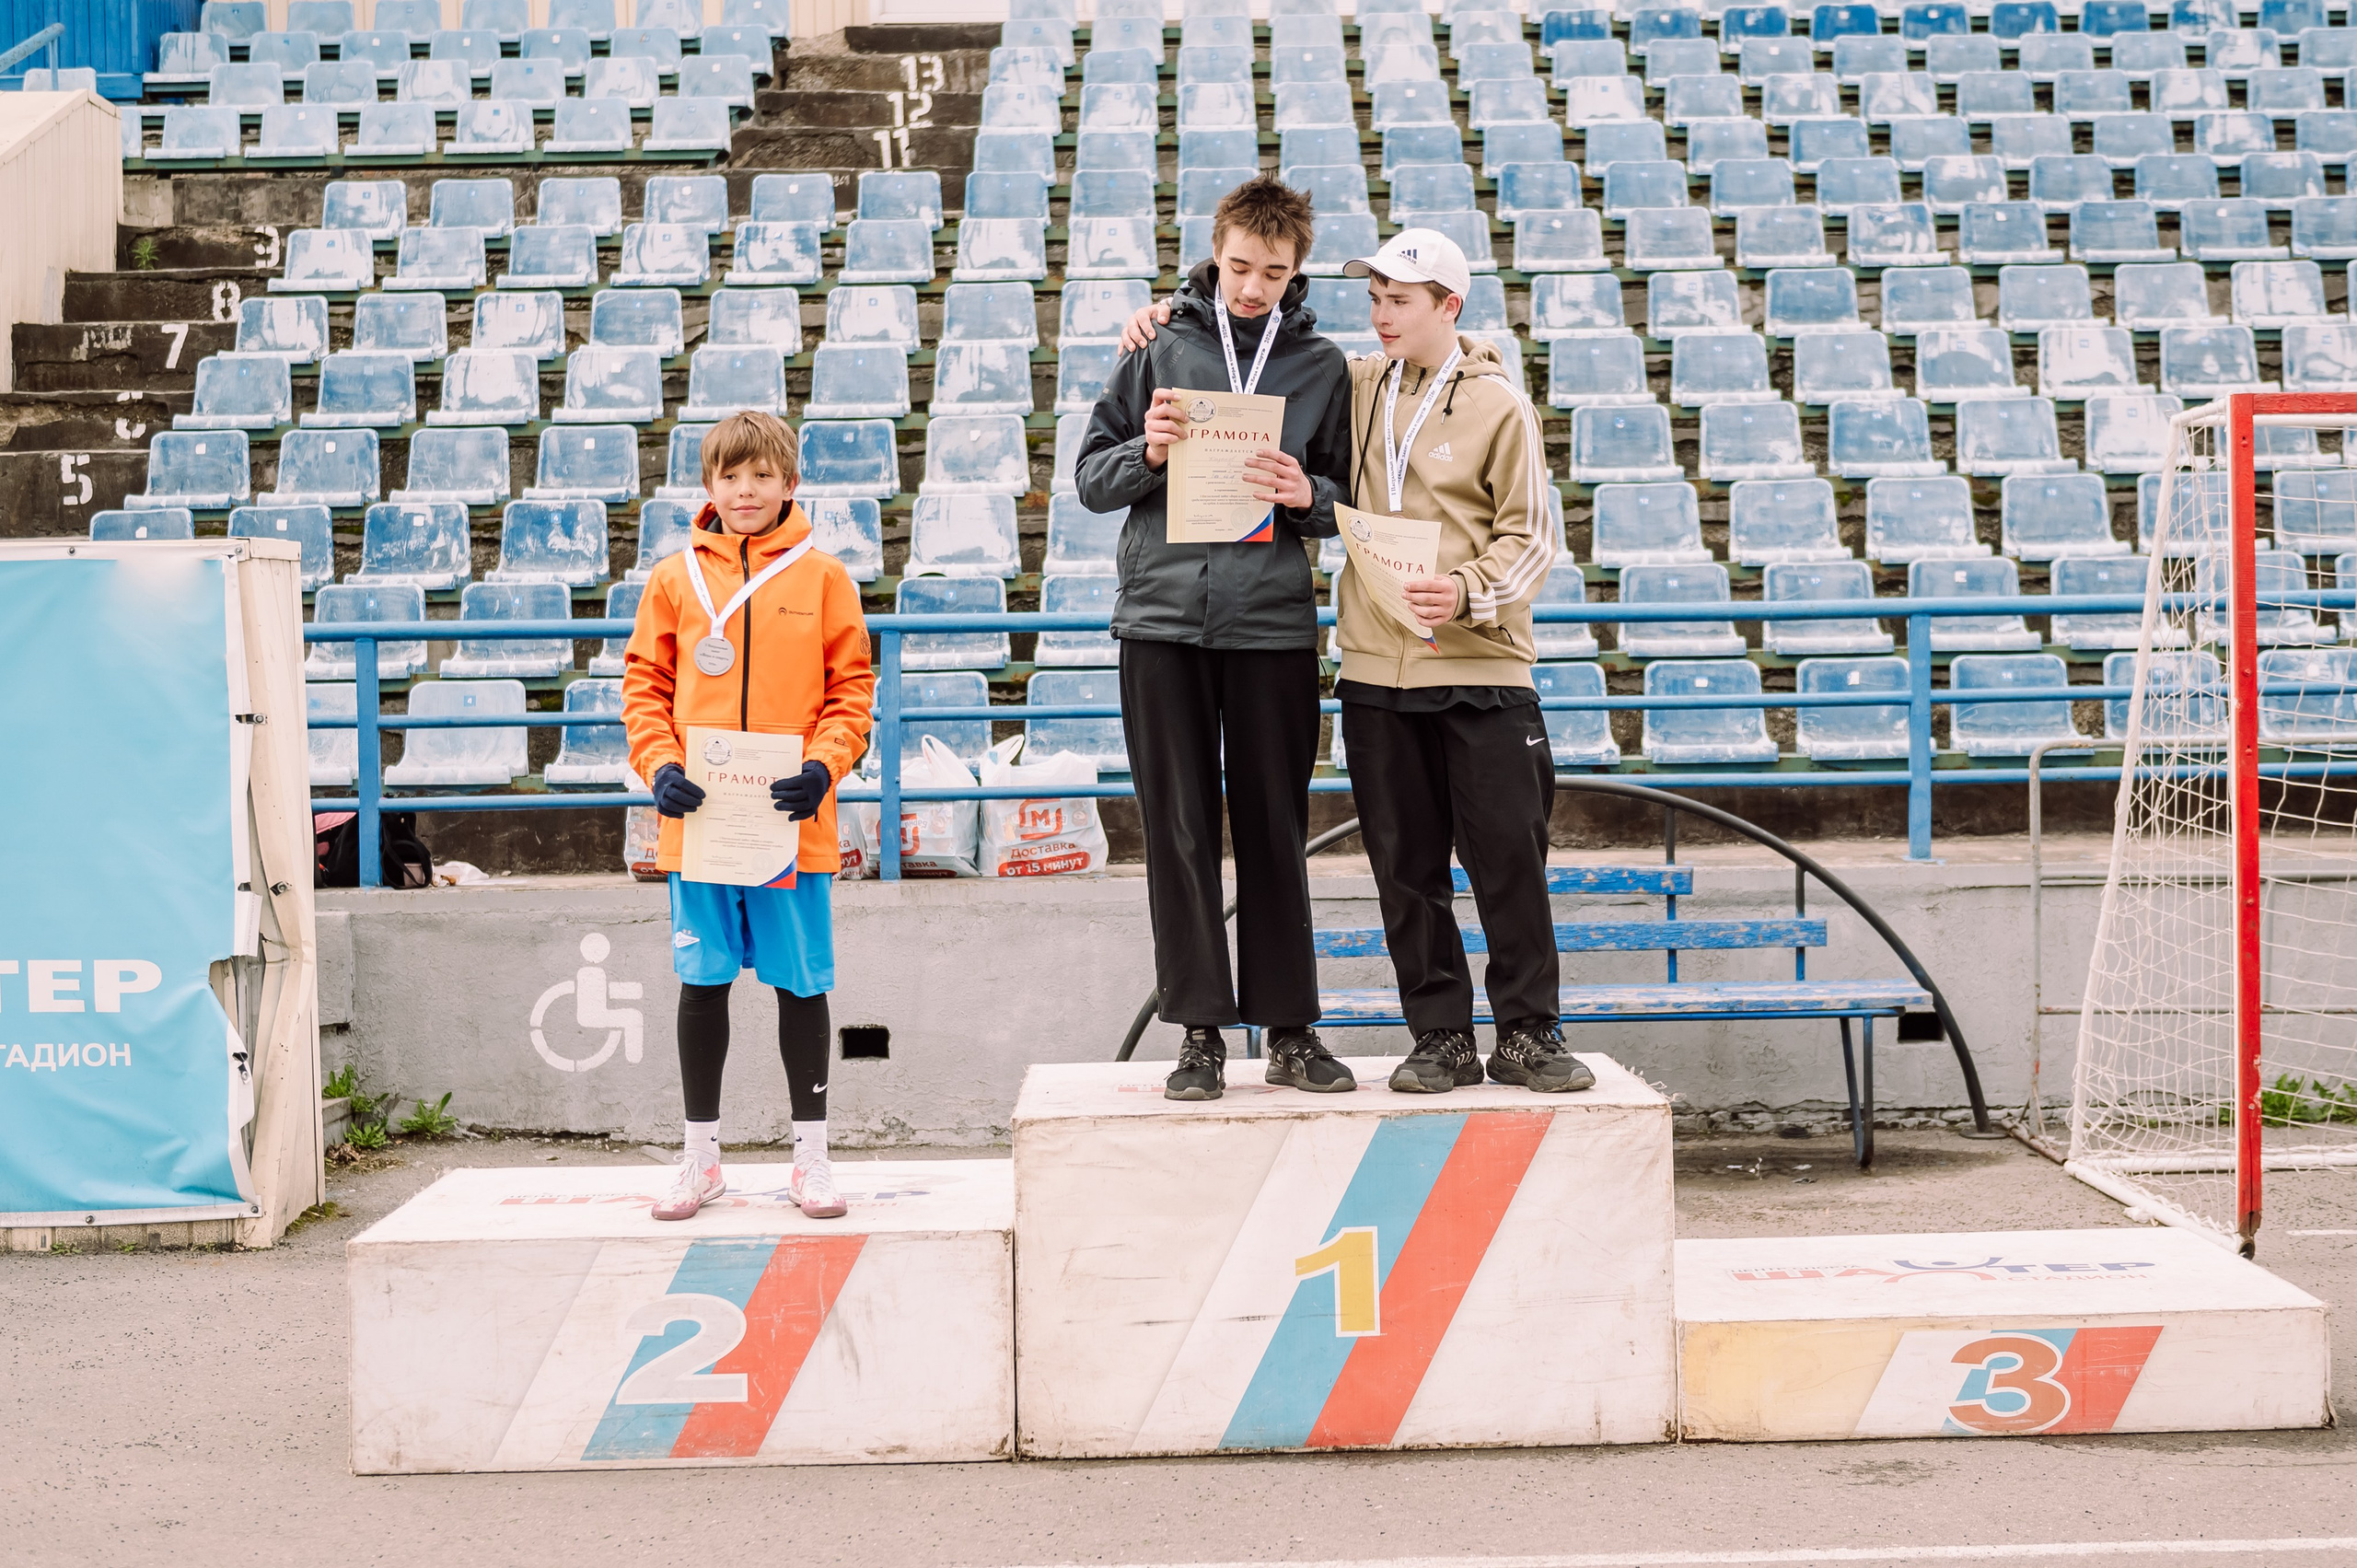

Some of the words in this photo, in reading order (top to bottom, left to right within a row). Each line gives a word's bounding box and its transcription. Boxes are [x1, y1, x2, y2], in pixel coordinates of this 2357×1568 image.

[900, 55, 945, 91] 13
[887, 91, 934, 128] 12
[873, 127, 911, 168] 11
[212, 280, 241, 322] 8
[161, 323, 189, 368] 7
[1190, 428, 1271, 442] ГРАМОТА
[1428, 451, 1454, 462] adidas
[60, 454, 93, 505] 5
[1355, 542, 1424, 575] ГРАМОТА
[1006, 866, 1022, 876] от
[1026, 863, 1040, 874] 15
[1043, 856, 1084, 872] минут
[1010, 842, 1076, 859] Доставка
[1295, 1225, 1380, 1338] 1
[616, 1293, 749, 1405] 2
[1947, 1331, 2072, 1434] 3
